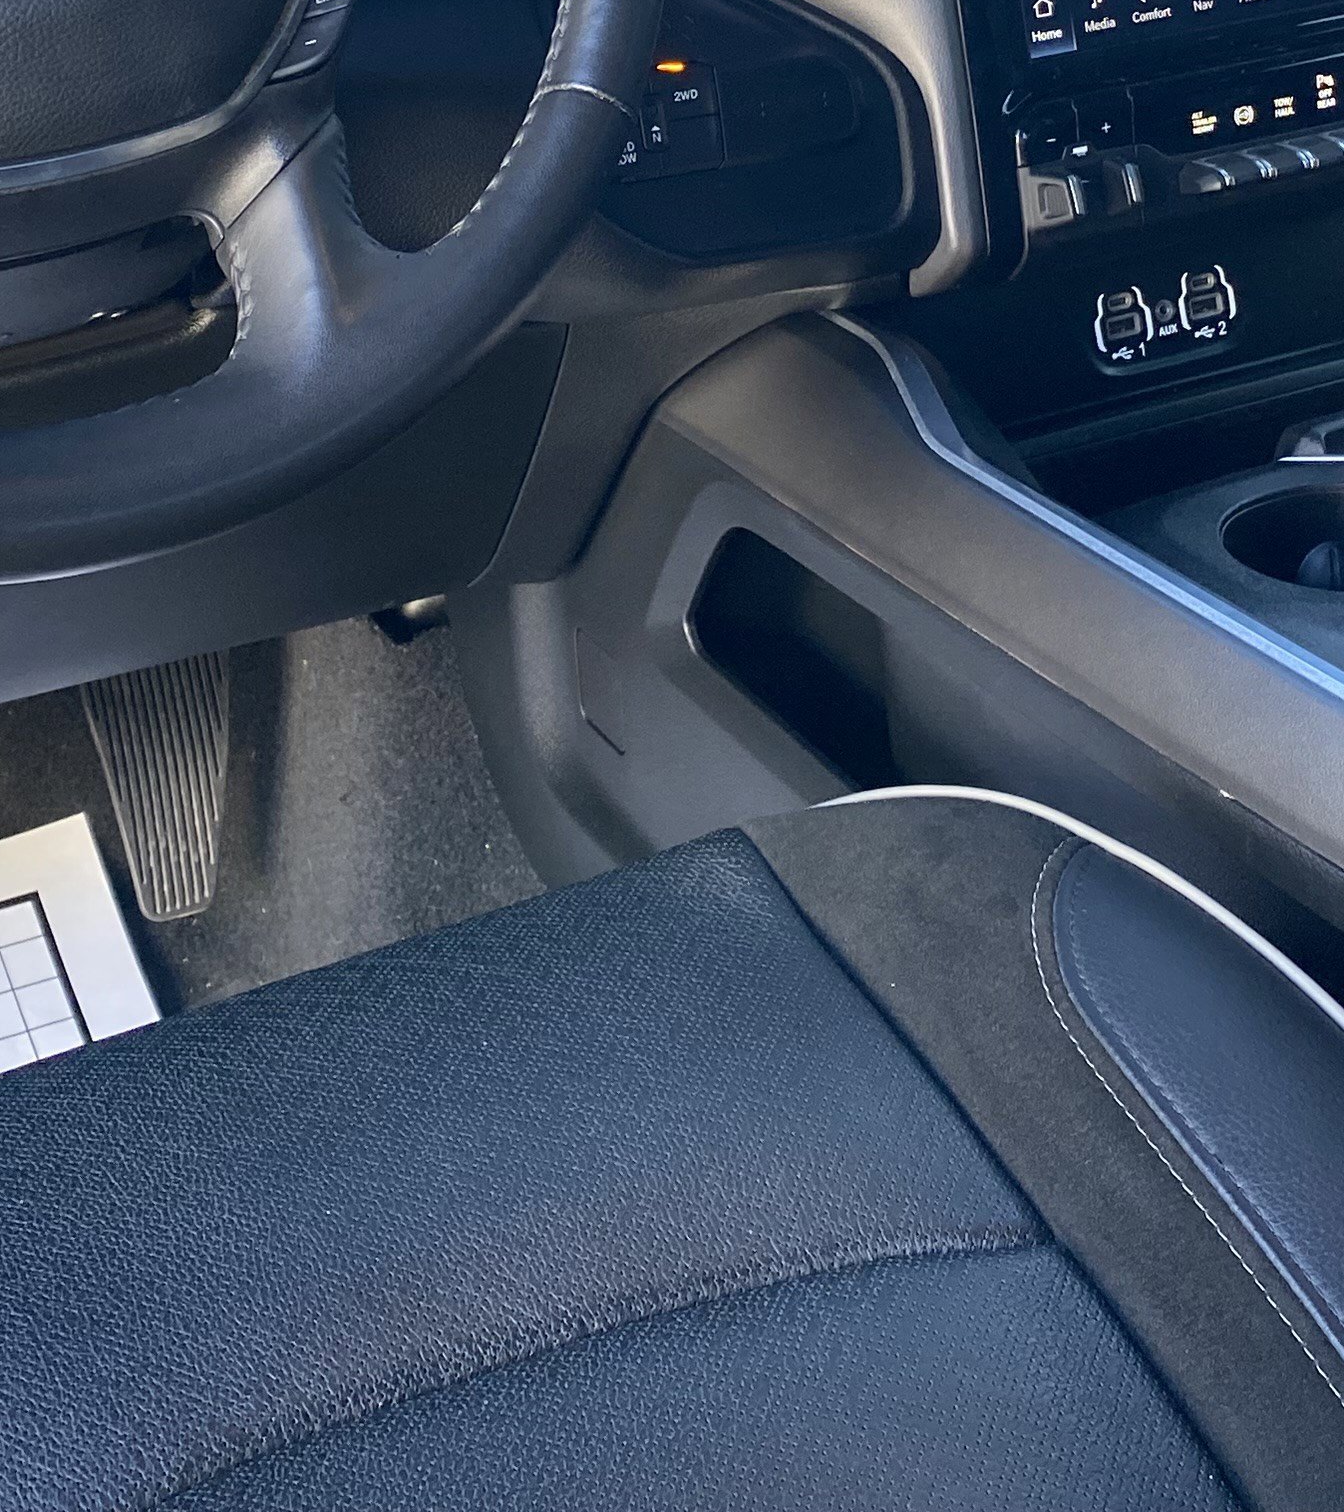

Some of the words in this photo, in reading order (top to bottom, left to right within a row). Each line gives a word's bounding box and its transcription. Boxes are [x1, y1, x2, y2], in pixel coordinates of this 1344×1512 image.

[1193, 0, 1214, 13] Nav
[1132, 6, 1172, 24] Comfort
[1084, 17, 1116, 33] Media
[1031, 27, 1063, 43] Home
[673, 88, 699, 103] 2WD
[652, 131, 663, 143] N
[617, 152, 638, 166] OW
[1159, 323, 1179, 337] AUX
[1217, 320, 1228, 336] 2
[1138, 341, 1146, 358] 1
